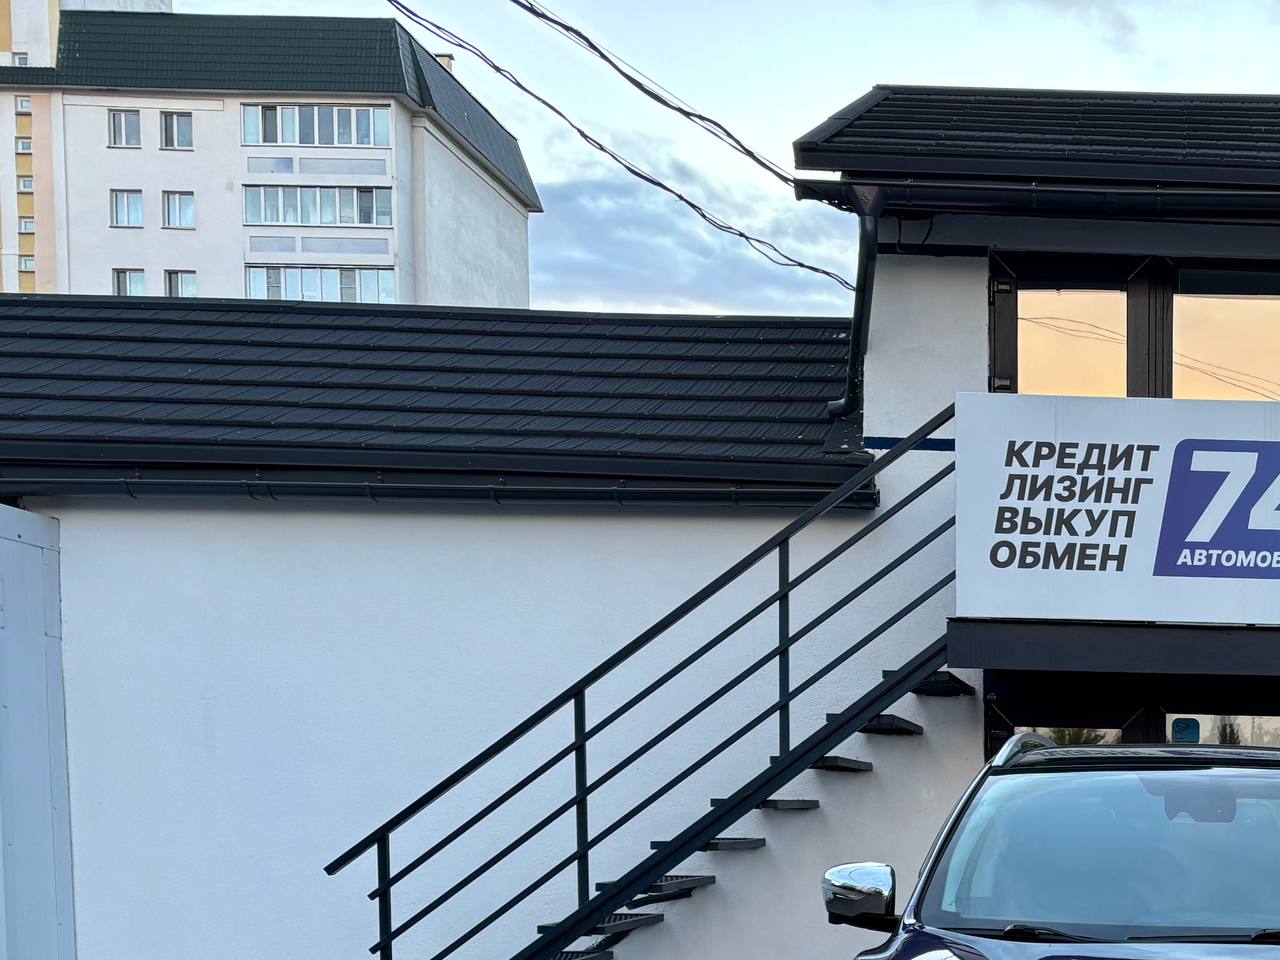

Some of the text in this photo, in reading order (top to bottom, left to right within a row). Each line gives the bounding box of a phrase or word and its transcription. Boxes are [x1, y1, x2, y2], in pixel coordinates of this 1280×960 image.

[1004, 440, 1160, 475] КРЕДИТ
[999, 474, 1154, 504] ЛИЗИНГ
[994, 506, 1136, 538] ВЫКУП
[989, 540, 1128, 572] ОБМЕН
